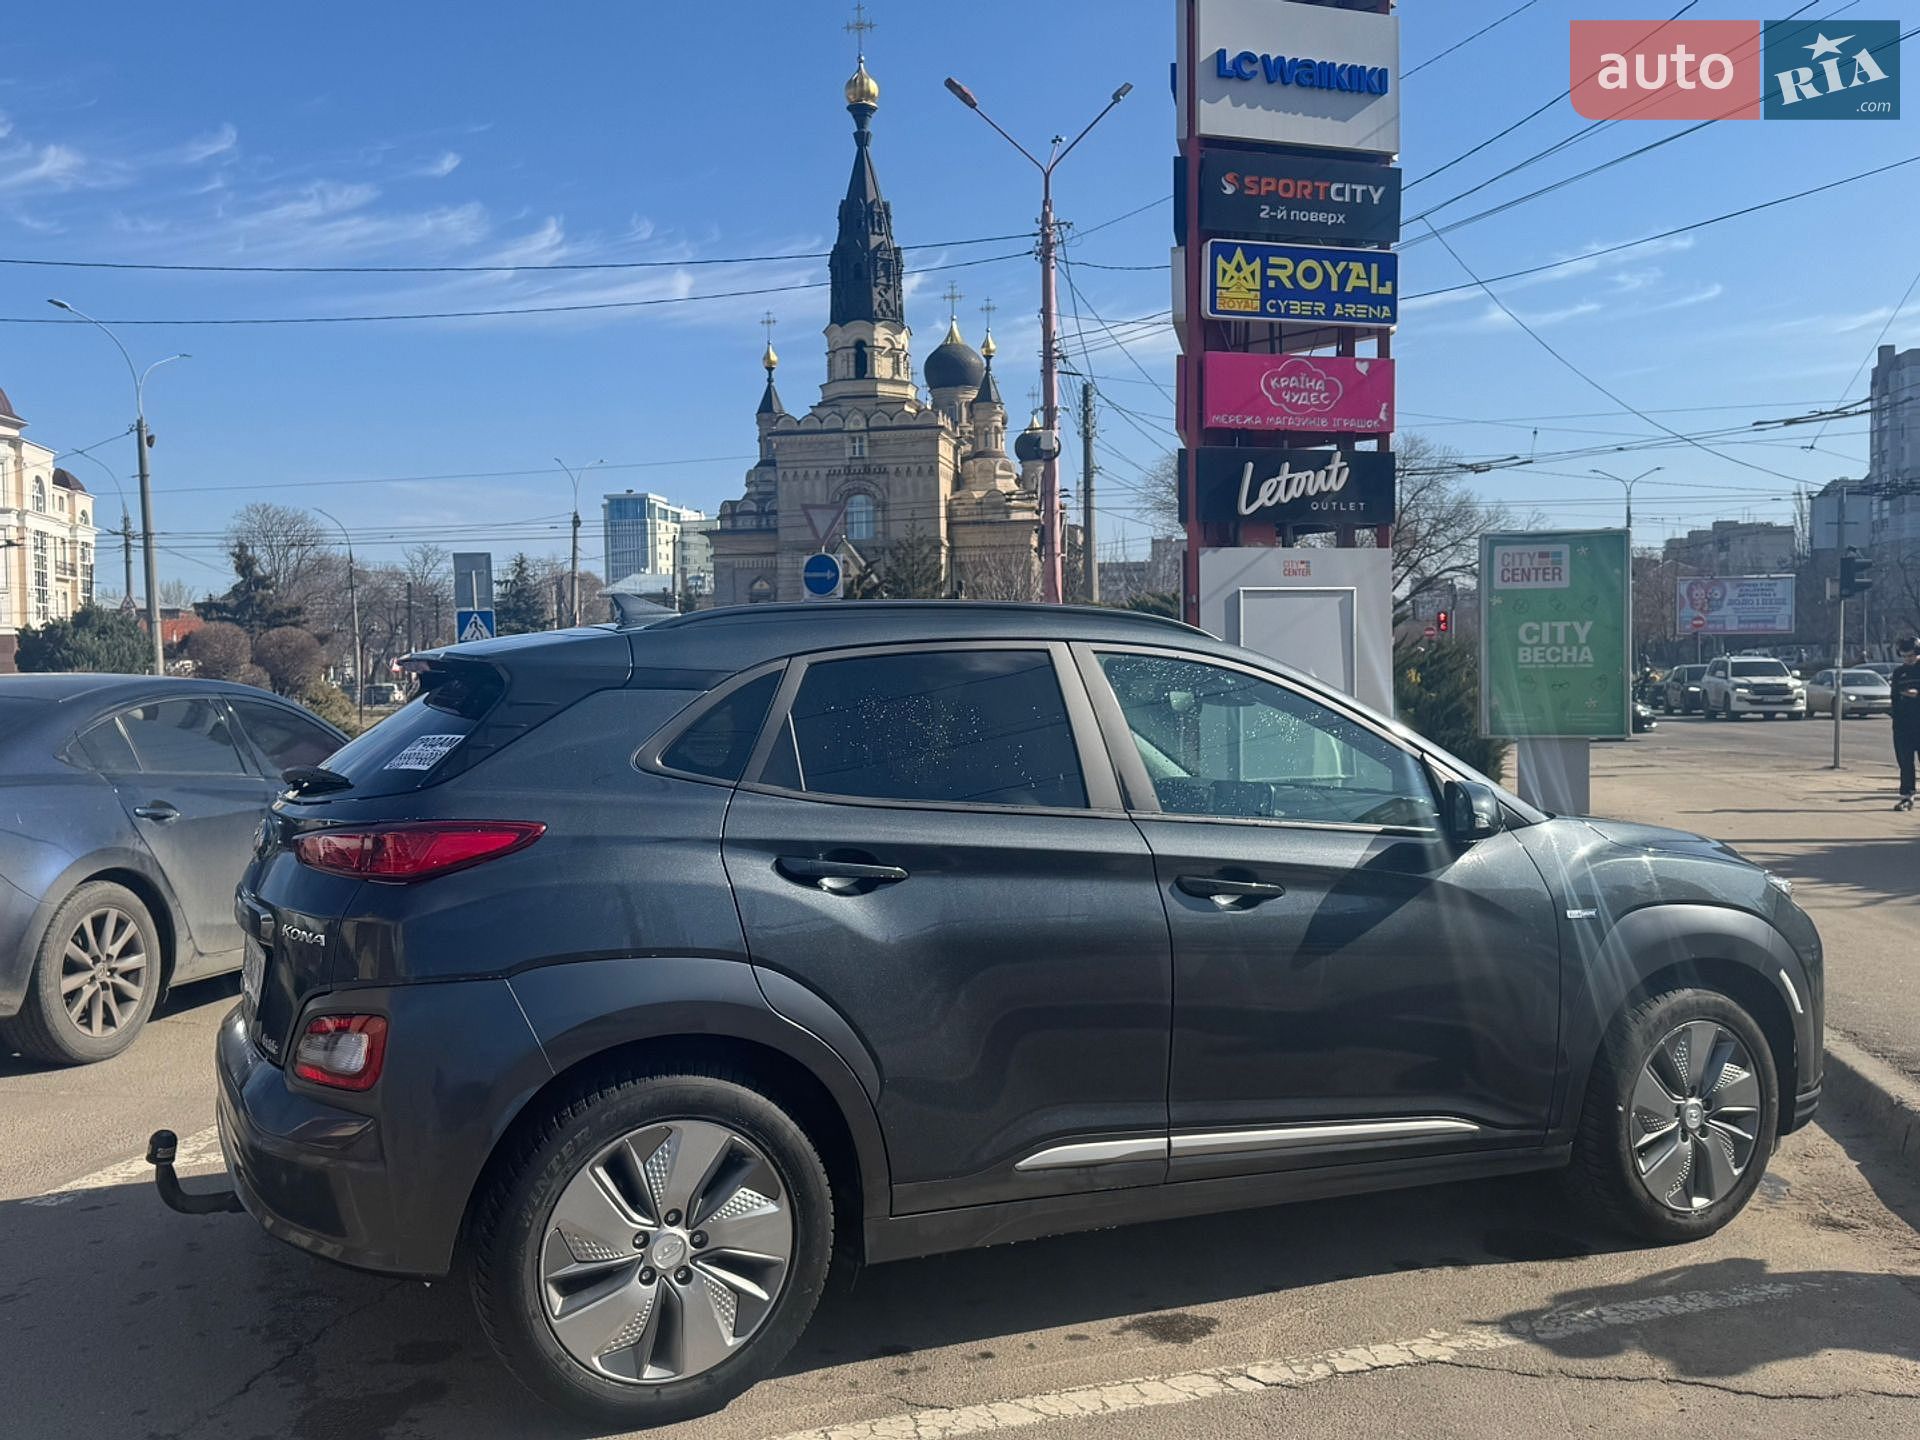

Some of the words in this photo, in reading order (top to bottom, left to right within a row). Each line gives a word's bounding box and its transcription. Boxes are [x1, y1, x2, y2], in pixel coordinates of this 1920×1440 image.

[1217, 48, 1258, 81] LC
[1244, 175, 1386, 205] SPORTCITY
[1260, 205, 1287, 220] 2-й
[1290, 209, 1346, 225] поверх
[1267, 256, 1392, 295] ROYAL
[1266, 299, 1325, 316] CYBER
[1333, 304, 1392, 319] ARENA
[1270, 373, 1326, 391] КРАЇНА
[1281, 391, 1330, 405] ЧУДЕС
[1212, 414, 1262, 425] МЕРЕЖА
[1333, 417, 1380, 428] ІГРАШОК
[1311, 501, 1366, 511] OUTLET
[1501, 552, 1537, 567] CITY
[1283, 568, 1312, 577] CENTER
[1501, 567, 1562, 583] CENTER
[1518, 621, 1593, 645] CITY
[1518, 646, 1594, 664] ВЕСНА
[282, 924, 326, 947] KONA
